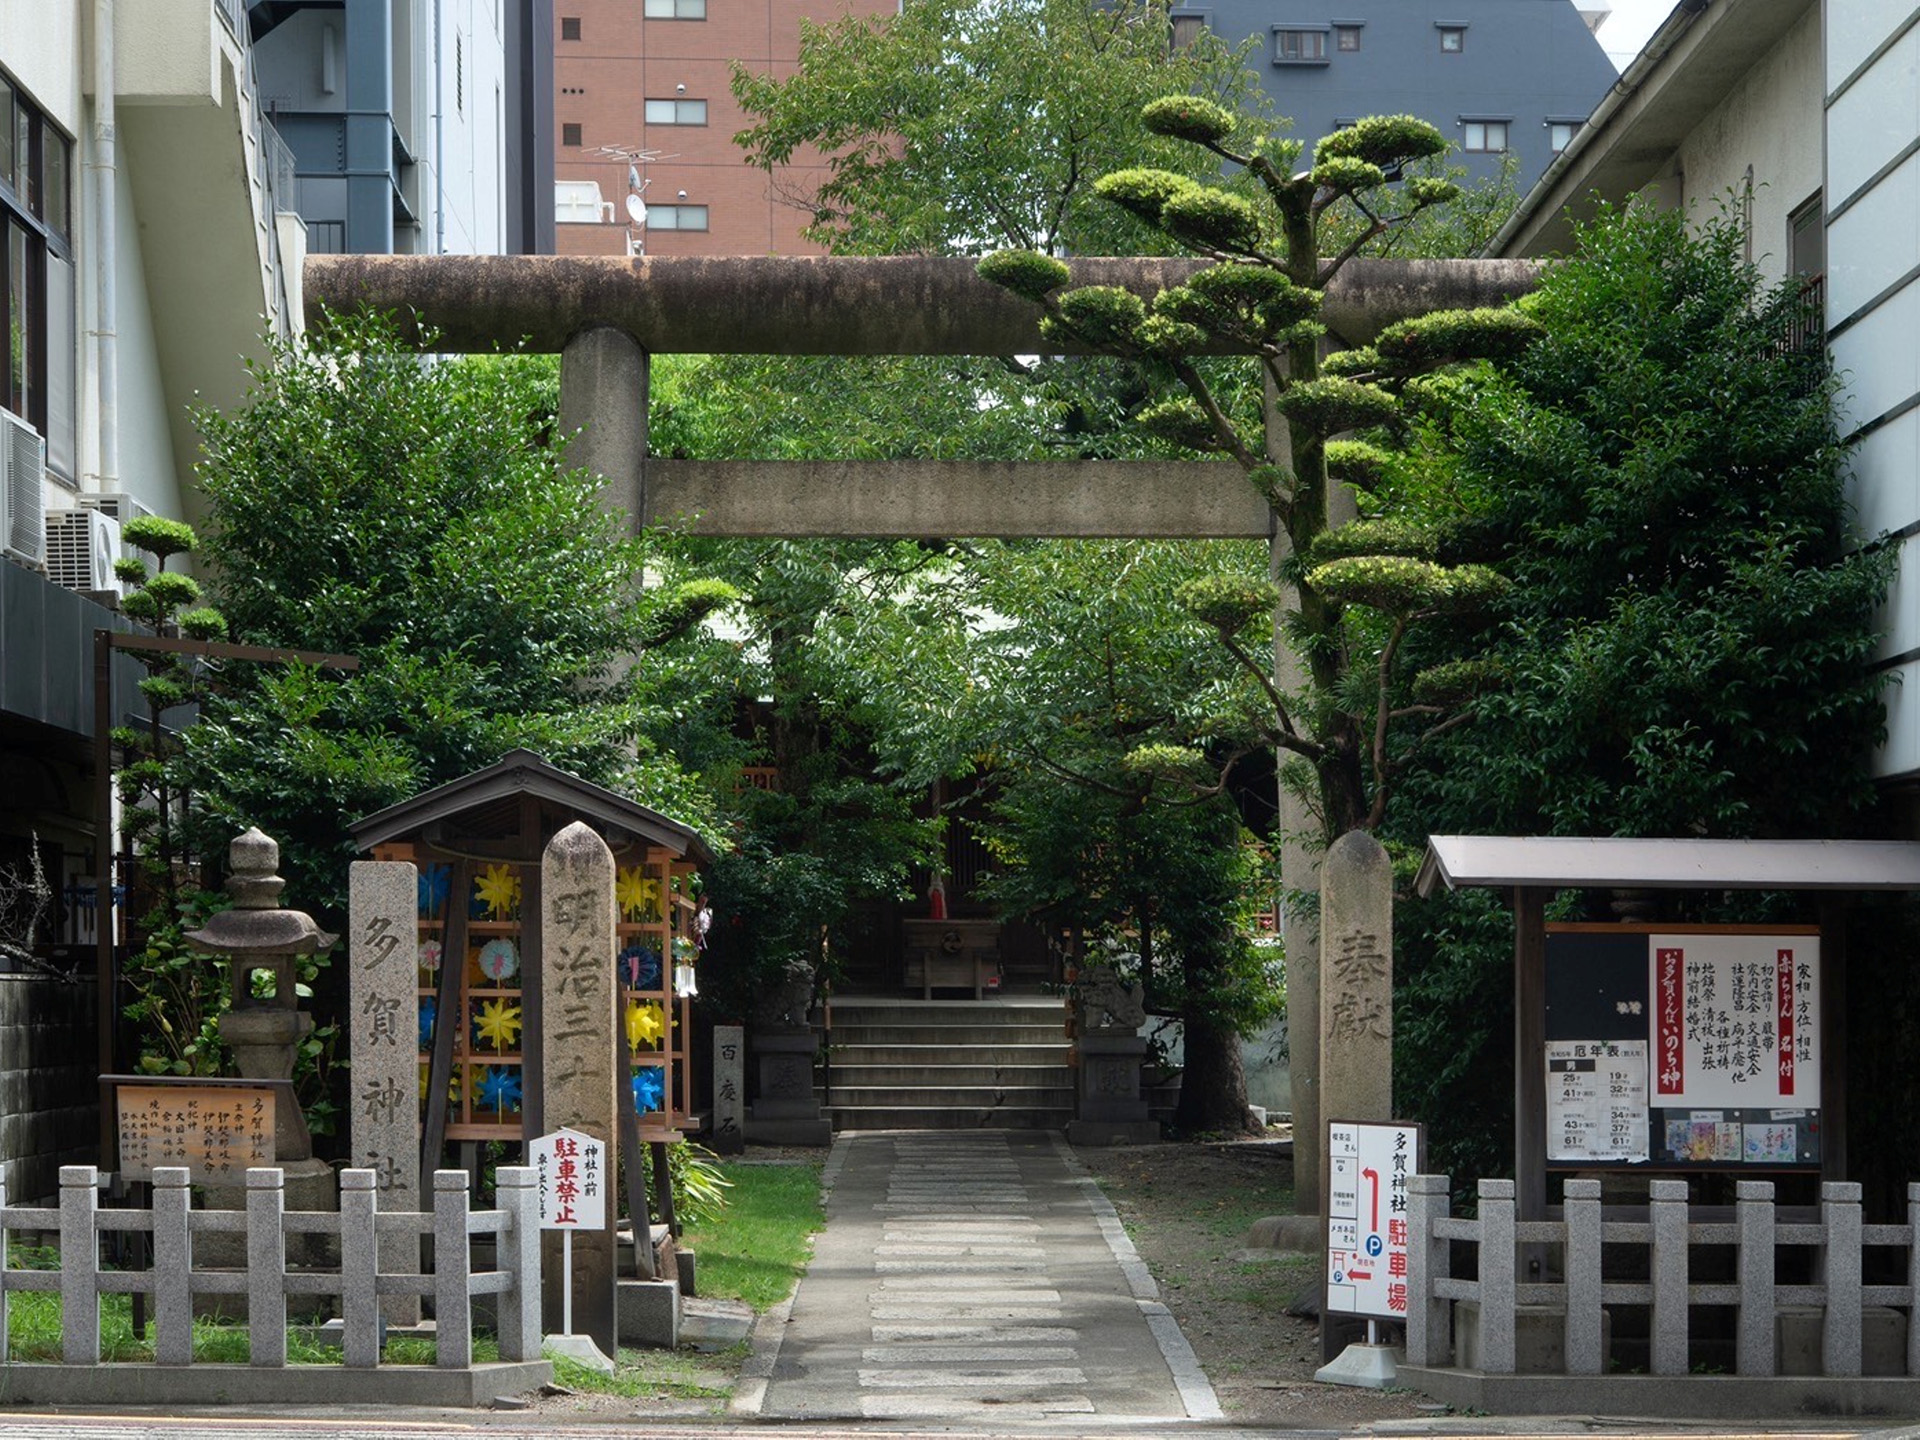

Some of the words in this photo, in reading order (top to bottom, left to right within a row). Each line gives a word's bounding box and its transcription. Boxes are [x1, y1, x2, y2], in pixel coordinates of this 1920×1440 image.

[1686, 962, 1701, 1042] 神前結婚式
[361, 915, 408, 1194] 多賀神社
[717, 1043, 739, 1134] 百度石
[251, 1097, 265, 1160] 多賀神社
[584, 1144, 598, 1197] 神社の前
[553, 1137, 580, 1224] 駐車禁止
[1389, 1131, 1407, 1213] 多賀神社
[1387, 1218, 1407, 1312] 駐車場
